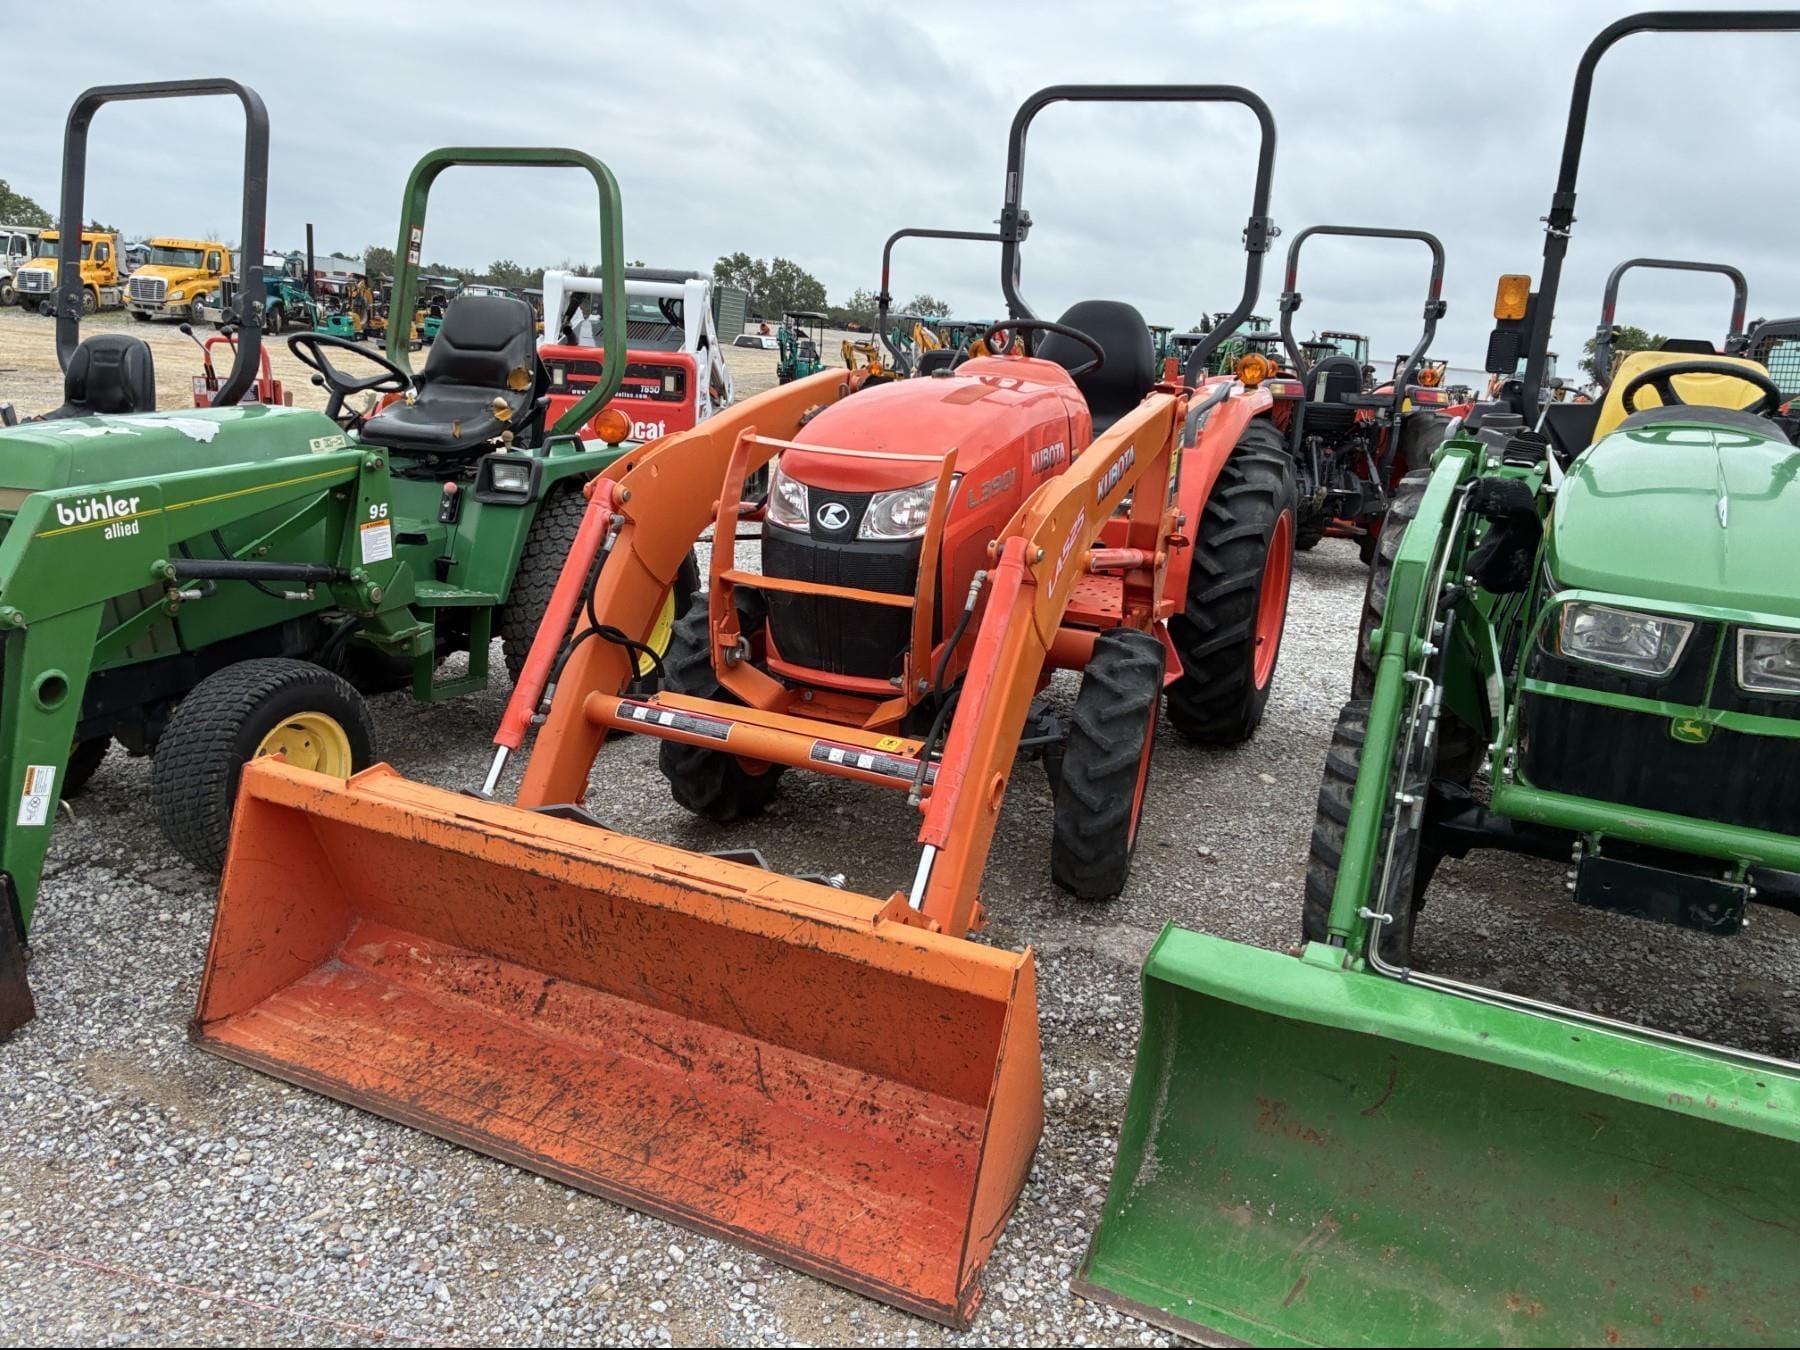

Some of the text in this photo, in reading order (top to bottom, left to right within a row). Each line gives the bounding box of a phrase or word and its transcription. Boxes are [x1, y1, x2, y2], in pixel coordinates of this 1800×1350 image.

[640, 385, 661, 395] T650
[1031, 441, 1066, 476] KUBOTA
[1097, 444, 1135, 506] KUBOTA
[56, 494, 140, 526] bühler
[369, 502, 389, 520] 95
[104, 519, 140, 540] allied
[1048, 505, 1086, 600] LA525
